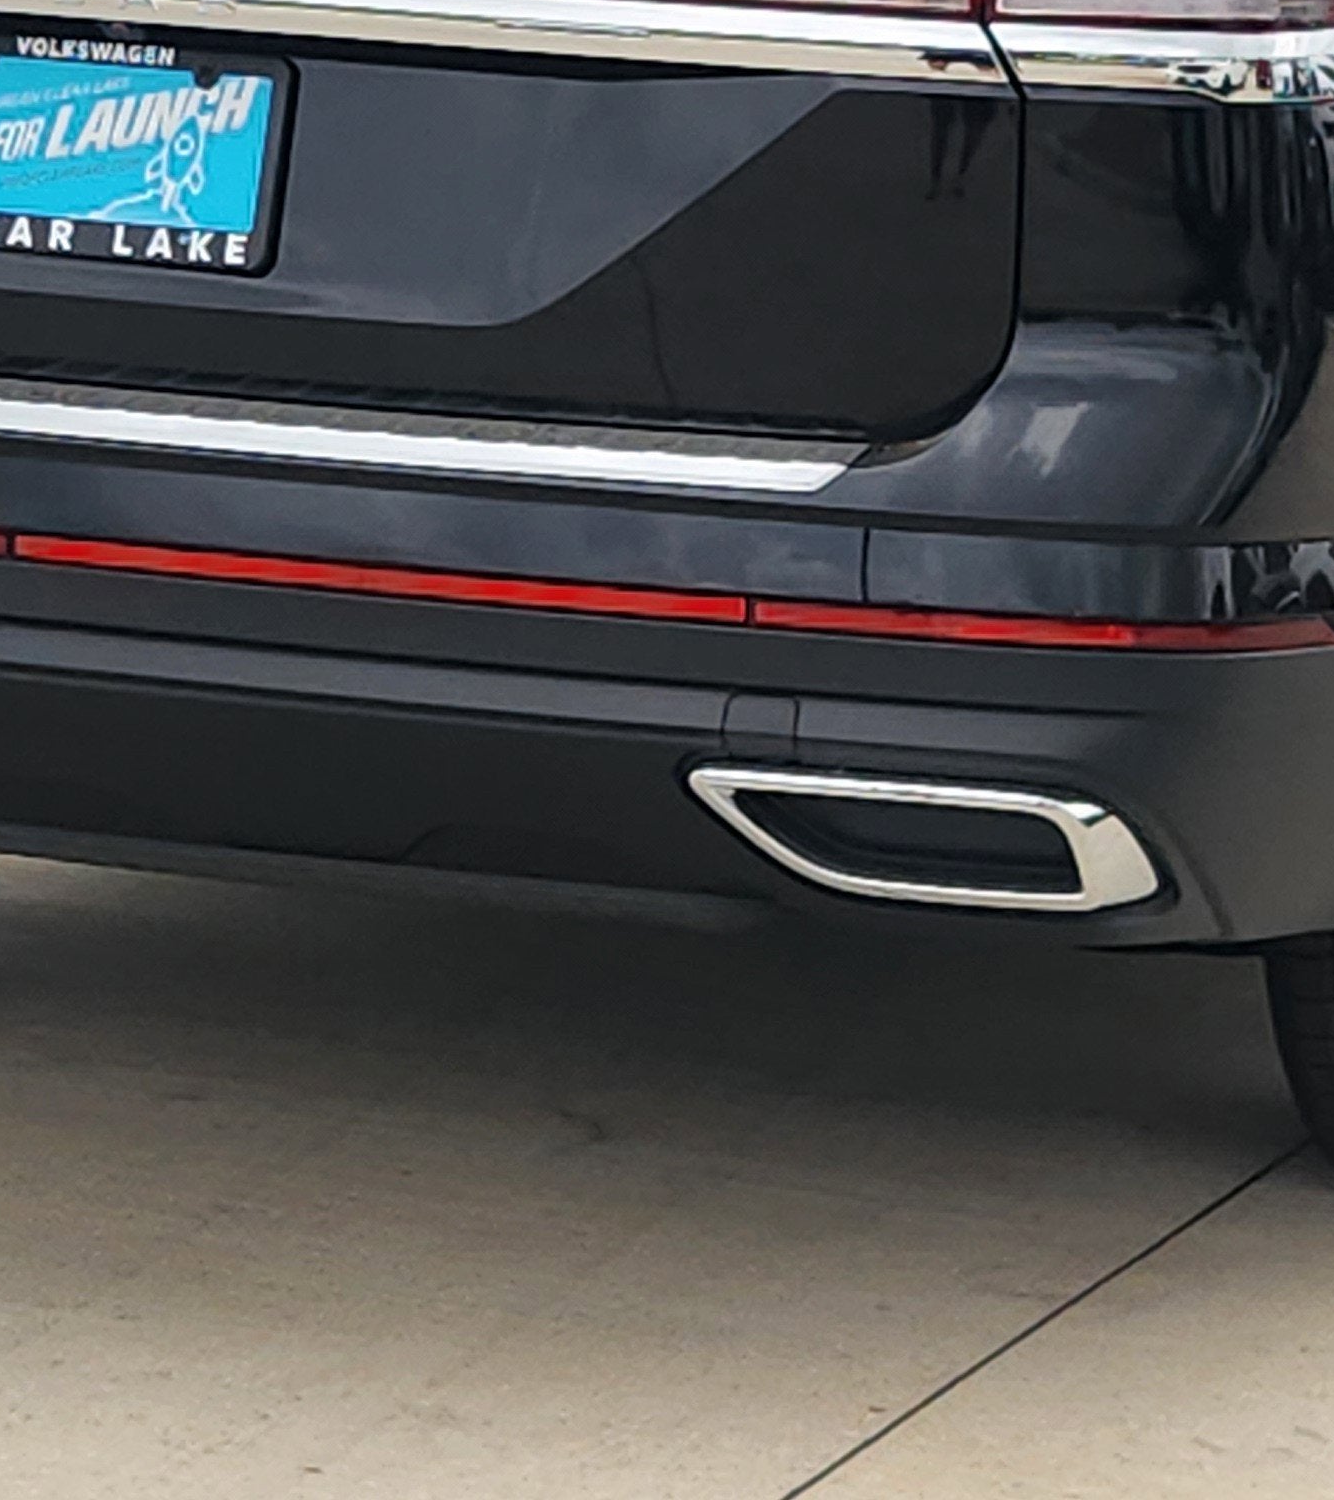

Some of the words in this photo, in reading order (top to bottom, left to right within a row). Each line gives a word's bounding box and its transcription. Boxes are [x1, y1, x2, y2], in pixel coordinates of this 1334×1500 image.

[15, 35, 177, 67] VOLKSWAGEN
[48, 77, 260, 159] LAUNCH
[111, 224, 250, 267] LAKE
